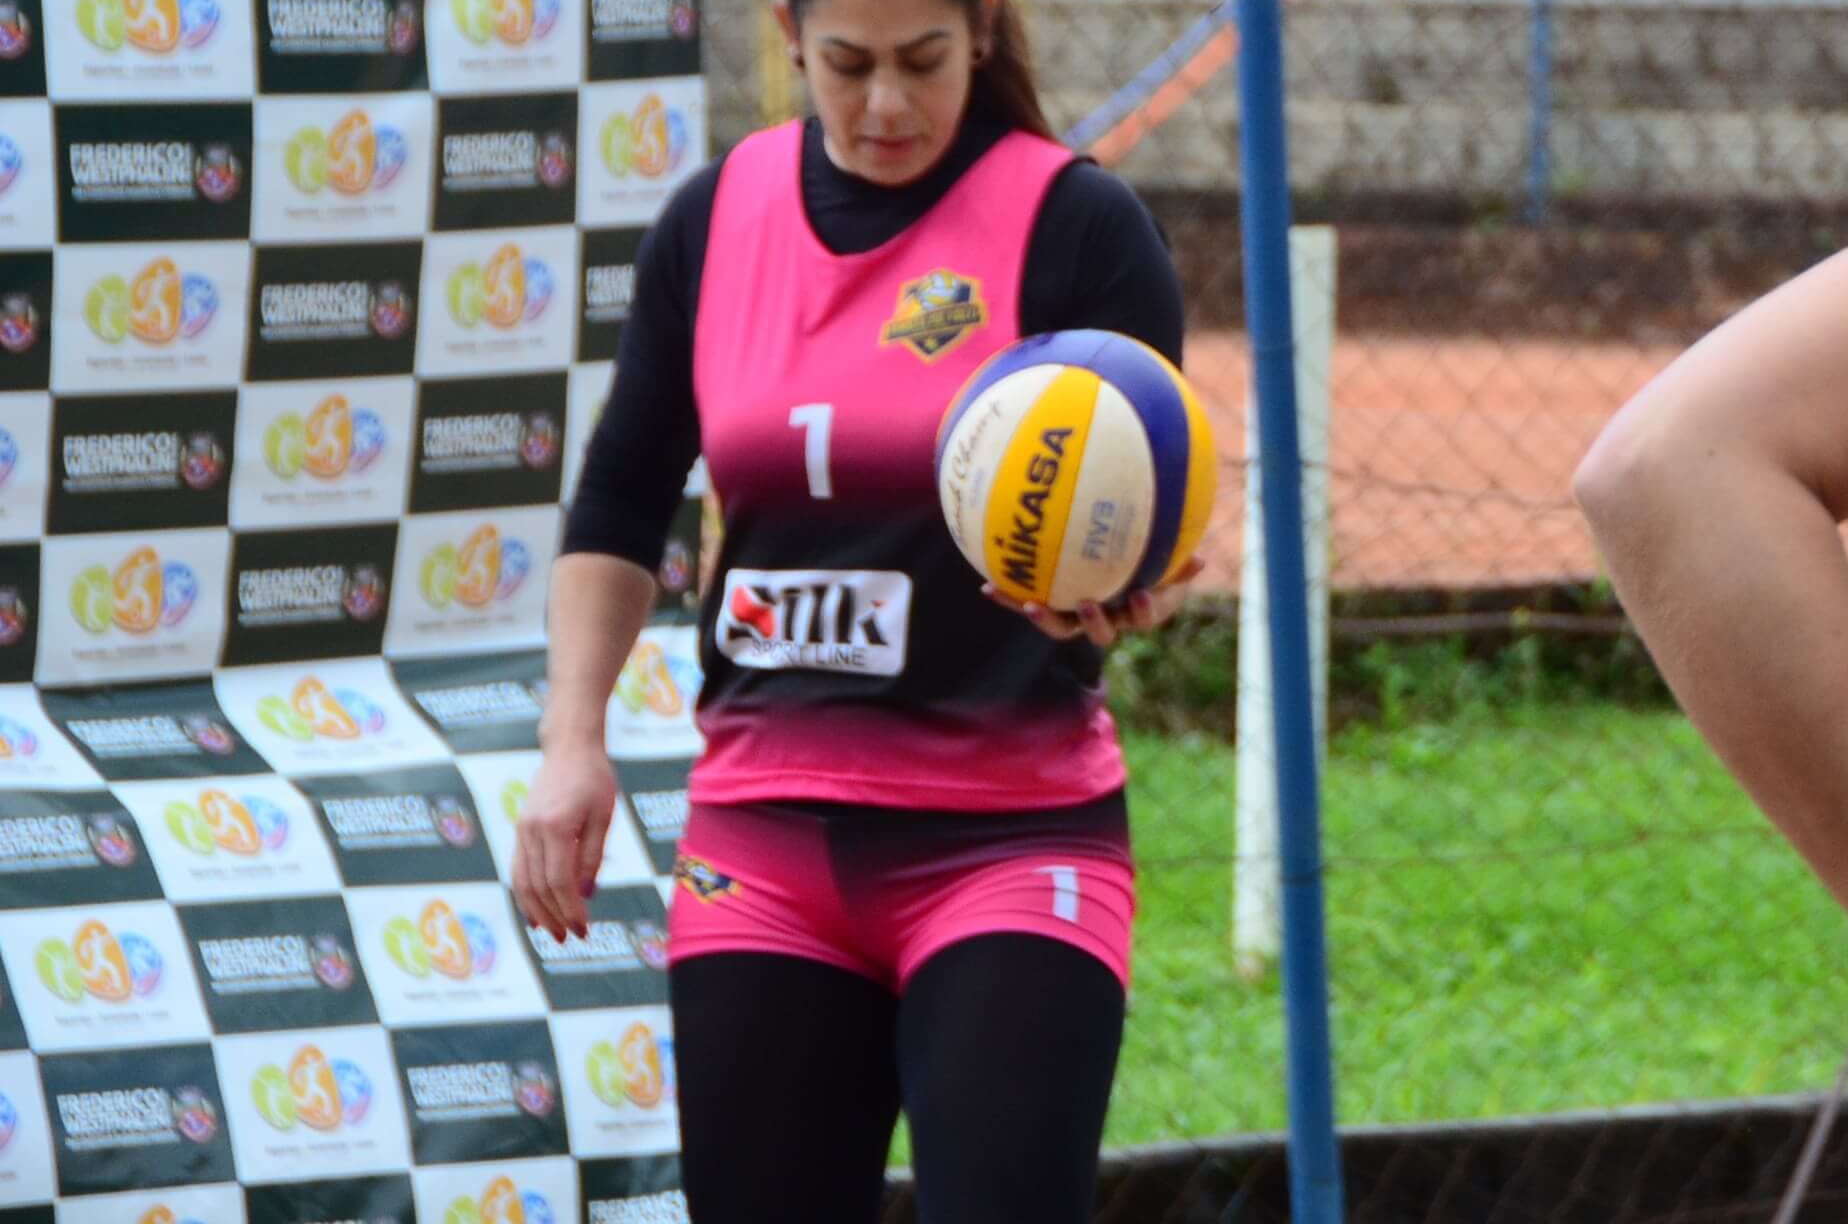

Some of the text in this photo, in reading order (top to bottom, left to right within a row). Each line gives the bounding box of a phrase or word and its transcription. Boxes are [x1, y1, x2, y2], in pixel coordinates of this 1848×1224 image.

[69, 143, 184, 163] FREDERICO
[260, 282, 362, 304] FREDERICO
[62, 432, 172, 455] FREDERICO
[788, 403, 835, 500] 1
[815, 645, 866, 667] LINE
[1033, 866, 1078, 923] 1
